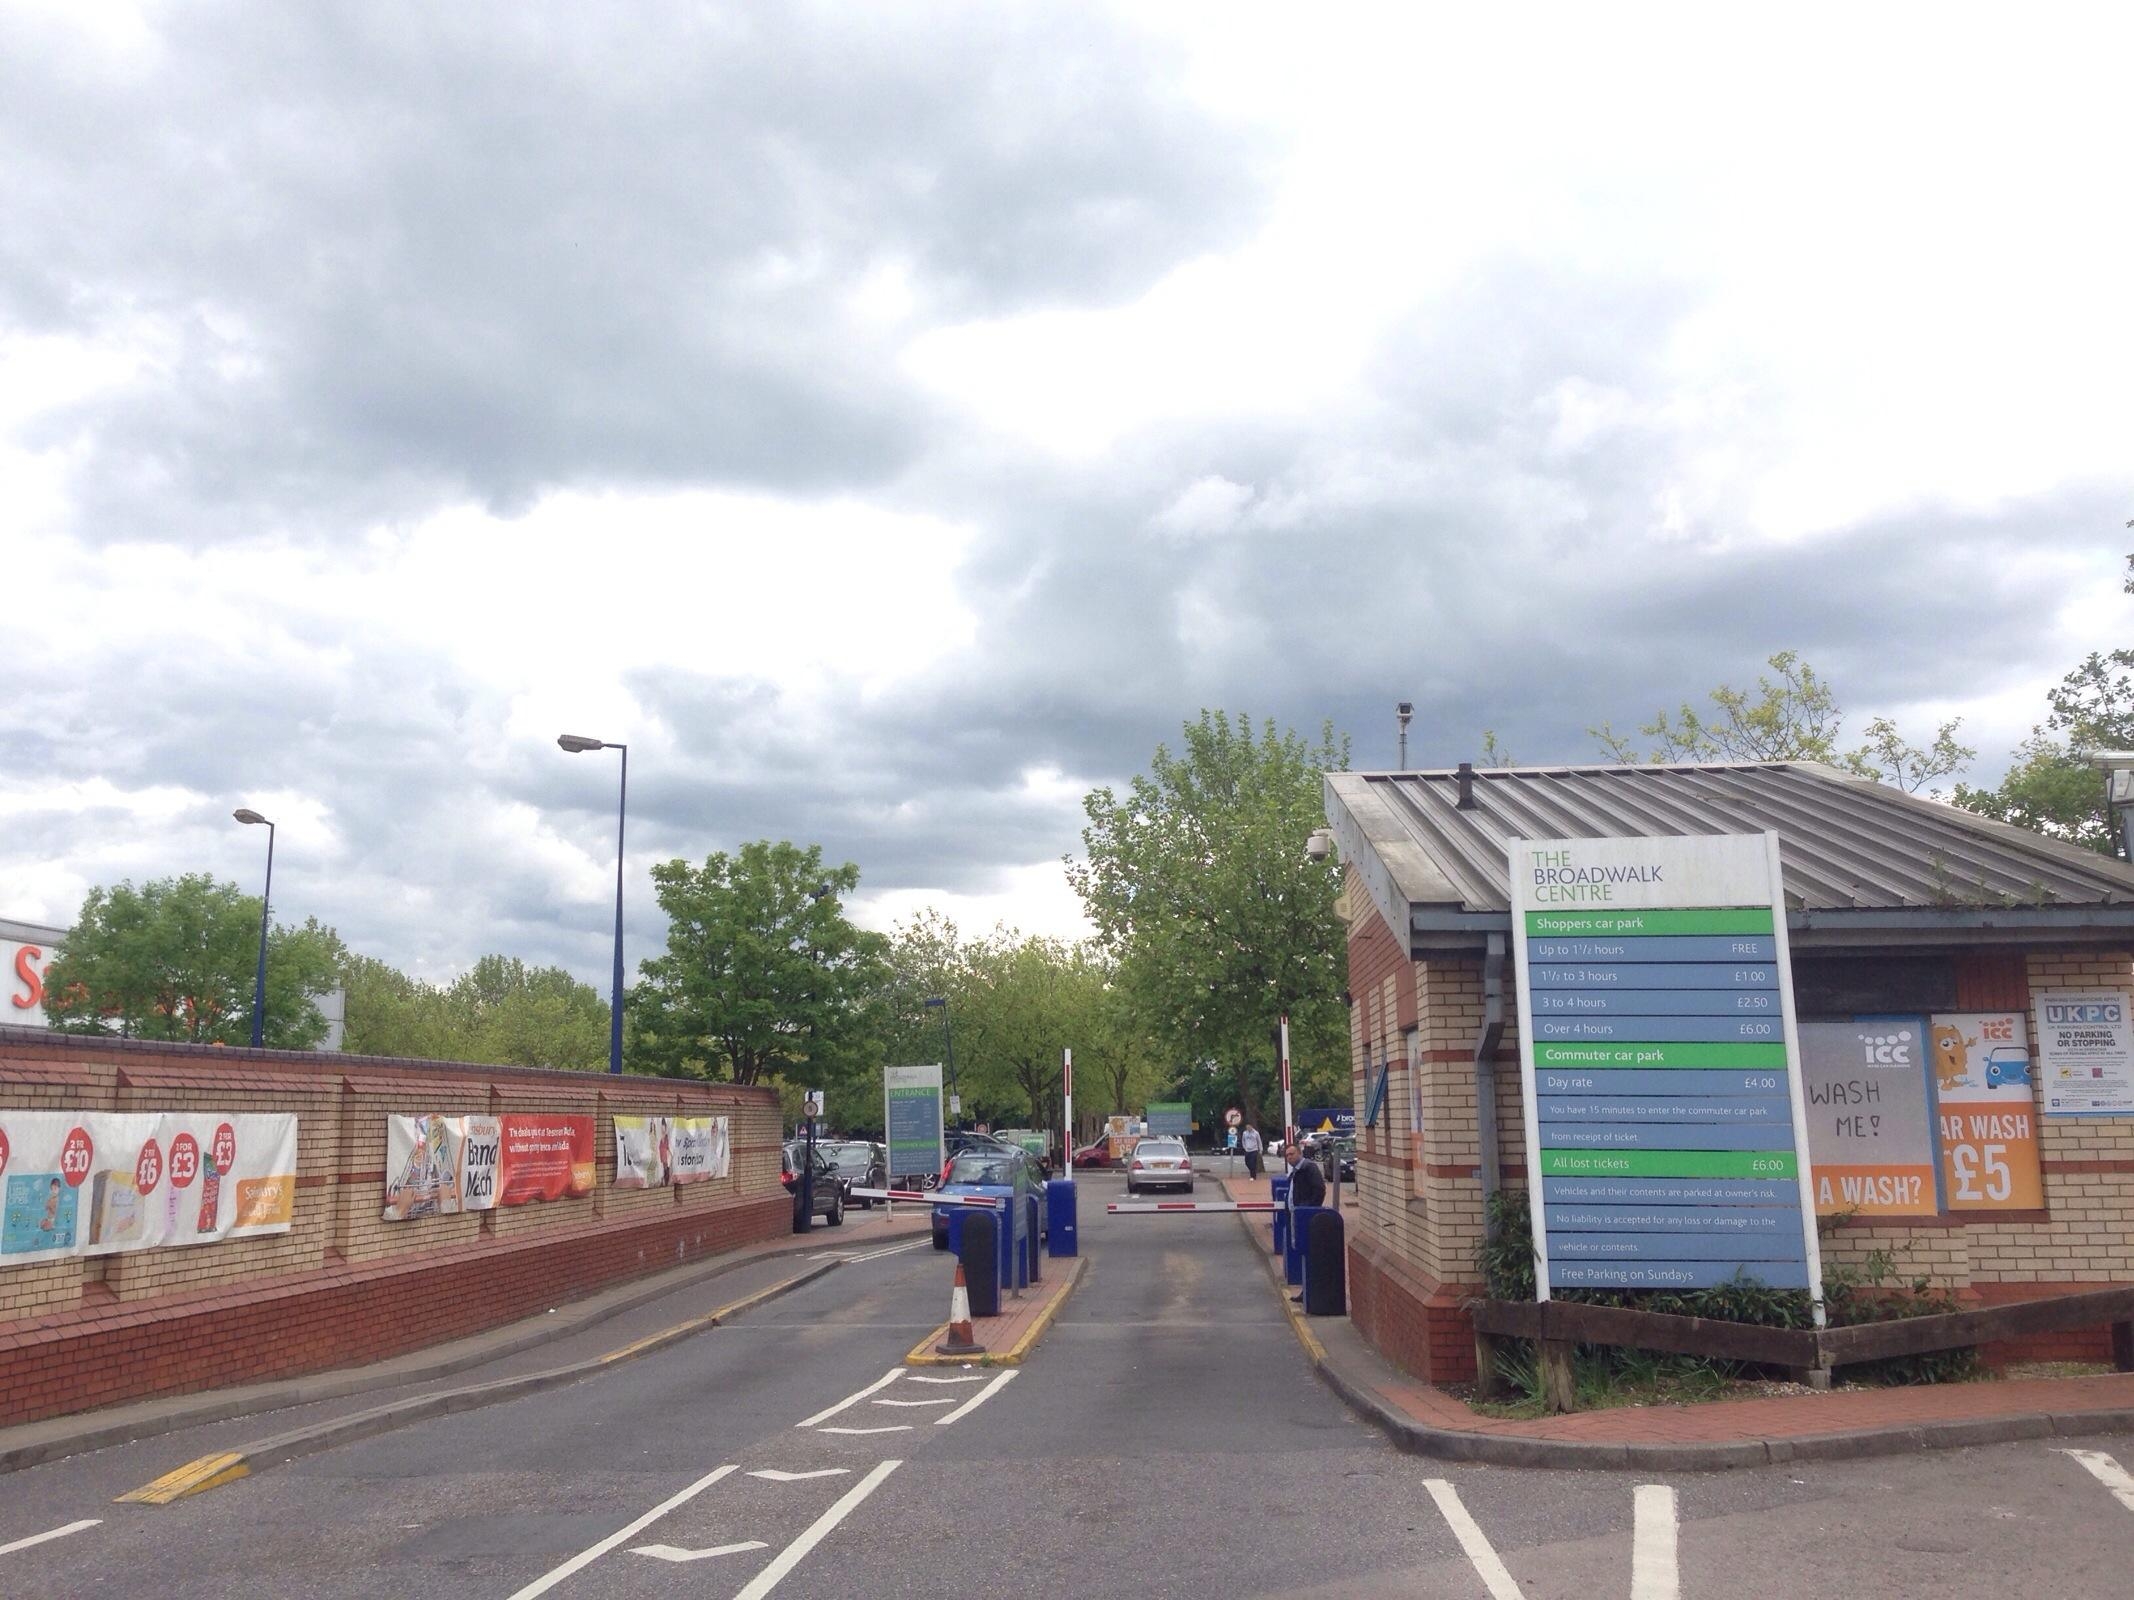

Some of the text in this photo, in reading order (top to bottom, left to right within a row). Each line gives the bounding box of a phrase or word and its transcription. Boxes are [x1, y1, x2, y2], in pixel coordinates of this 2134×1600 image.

[1532, 851, 1571, 867] THE
[1534, 865, 1663, 884] BROADWALK
[1536, 884, 1612, 902] CENTRE
[1537, 918, 1644, 931] Shoppers car park
[1539, 944, 1554, 956] Up
[1558, 946, 1569, 954] to
[1594, 944, 1624, 955] hours
[1732, 944, 1758, 953] FREE
[1564, 972, 1574, 980] to
[1579, 971, 1585, 980] 3
[1588, 971, 1618, 981] hours
[1736, 971, 1765, 981] £1.00
[1543, 997, 1606, 1008] 3 to 4 hours
[1738, 997, 1768, 1007] £2.50
[2048, 1006, 2120, 1022] UKPC
[1544, 1024, 1613, 1034] Over 4 hours
[1740, 1024, 1770, 1034] £6.00
[2072, 1039, 2116, 1047] STOPPING
[1546, 1049, 1664, 1063] Commuter car park
[1548, 1077, 1592, 1089] Day rate
[1745, 1078, 1775, 1088] £4.00
[1809, 1080, 1880, 1105] WASH
[1550, 1106, 1565, 1114] You
[1567, 1106, 1586, 1114] have
[1602, 1106, 1634, 1114] minutes
[1673, 1107, 1685, 1115] the
[1689, 1107, 1732, 1115] commuter
[1750, 1107, 1768, 1117] park
[1836, 1115, 1880, 1137] ME!
[1970, 1115, 2029, 1139] WASH
[1573, 1134, 1601, 1142] receipt
[1603, 1133, 1612, 1141] of
[70, 1140, 75, 1148] 2
[180, 1143, 192, 1151] FOR
[216, 1142, 232, 1166] £3
[64, 1150, 89, 1172] £10
[172, 1152, 194, 1178] £3
[1553, 1158, 1630, 1169] All lost tickets
[1753, 1160, 1784, 1170] £6.00
[139, 1158, 157, 1185] £6
[1952, 1144, 2011, 1200] £5
[1554, 1187, 1588, 1195] Vehicles
[1590, 1187, 1606, 1195] and
[1608, 1187, 1626, 1196] their
[1630, 1188, 1666, 1196] contents
[1684, 1189, 1711, 1198] parked
[1726, 1189, 1758, 1197] owner's
[1820, 1176, 1921, 1205] A WASH?
[1556, 1215, 1569, 1223] No
[1572, 1215, 1601, 1224] liability
[1613, 1216, 1650, 1225] accepted
[1653, 1216, 1664, 1224] for
[1667, 1218, 1682, 1226] any
[1685, 1217, 1700, 1225] loss
[1714, 1217, 1747, 1228] damage
[1762, 1217, 1776, 1225] the
[1559, 1243, 1587, 1251] vehicle
[1561, 1269, 1694, 1283] Free Parking on Sundays
